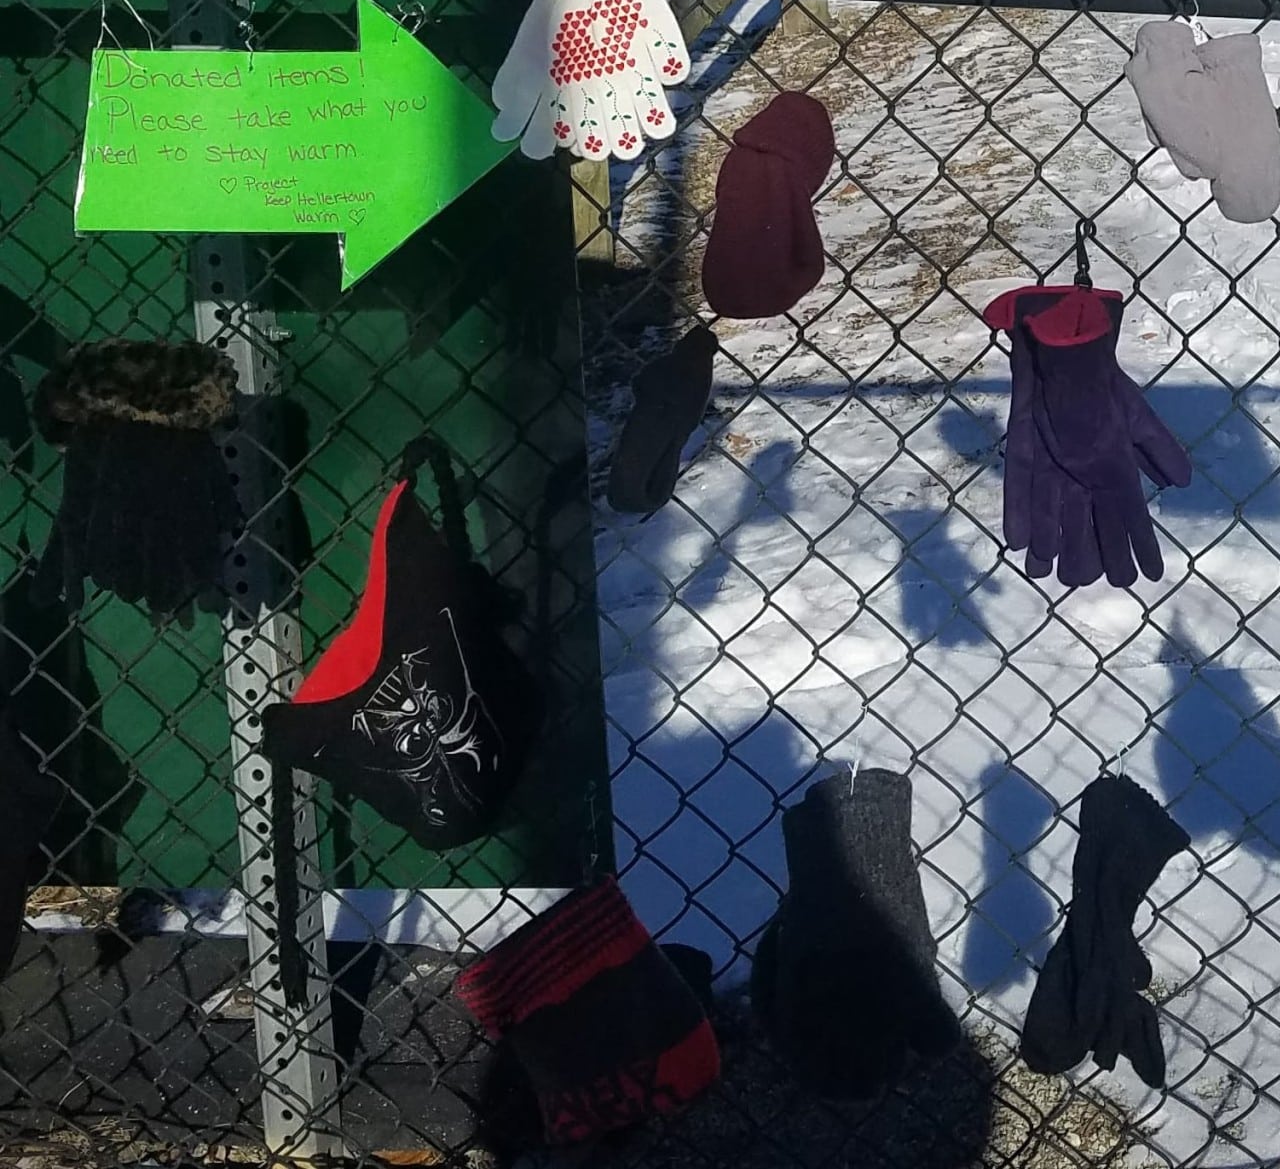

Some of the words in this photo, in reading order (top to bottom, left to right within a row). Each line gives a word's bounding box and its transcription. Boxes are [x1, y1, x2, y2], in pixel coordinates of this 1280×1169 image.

[104, 53, 242, 89] Donated
[267, 58, 366, 88] items!
[101, 96, 208, 133] Please
[228, 104, 292, 129] take
[307, 98, 368, 123] what
[384, 95, 428, 121] you
[89, 144, 138, 165] need
[157, 144, 188, 162] to
[205, 143, 268, 170] stay
[243, 175, 299, 195] Project
[265, 194, 292, 207] Keep
[297, 190, 376, 206] Hellertown
[293, 209, 339, 224] Warm
